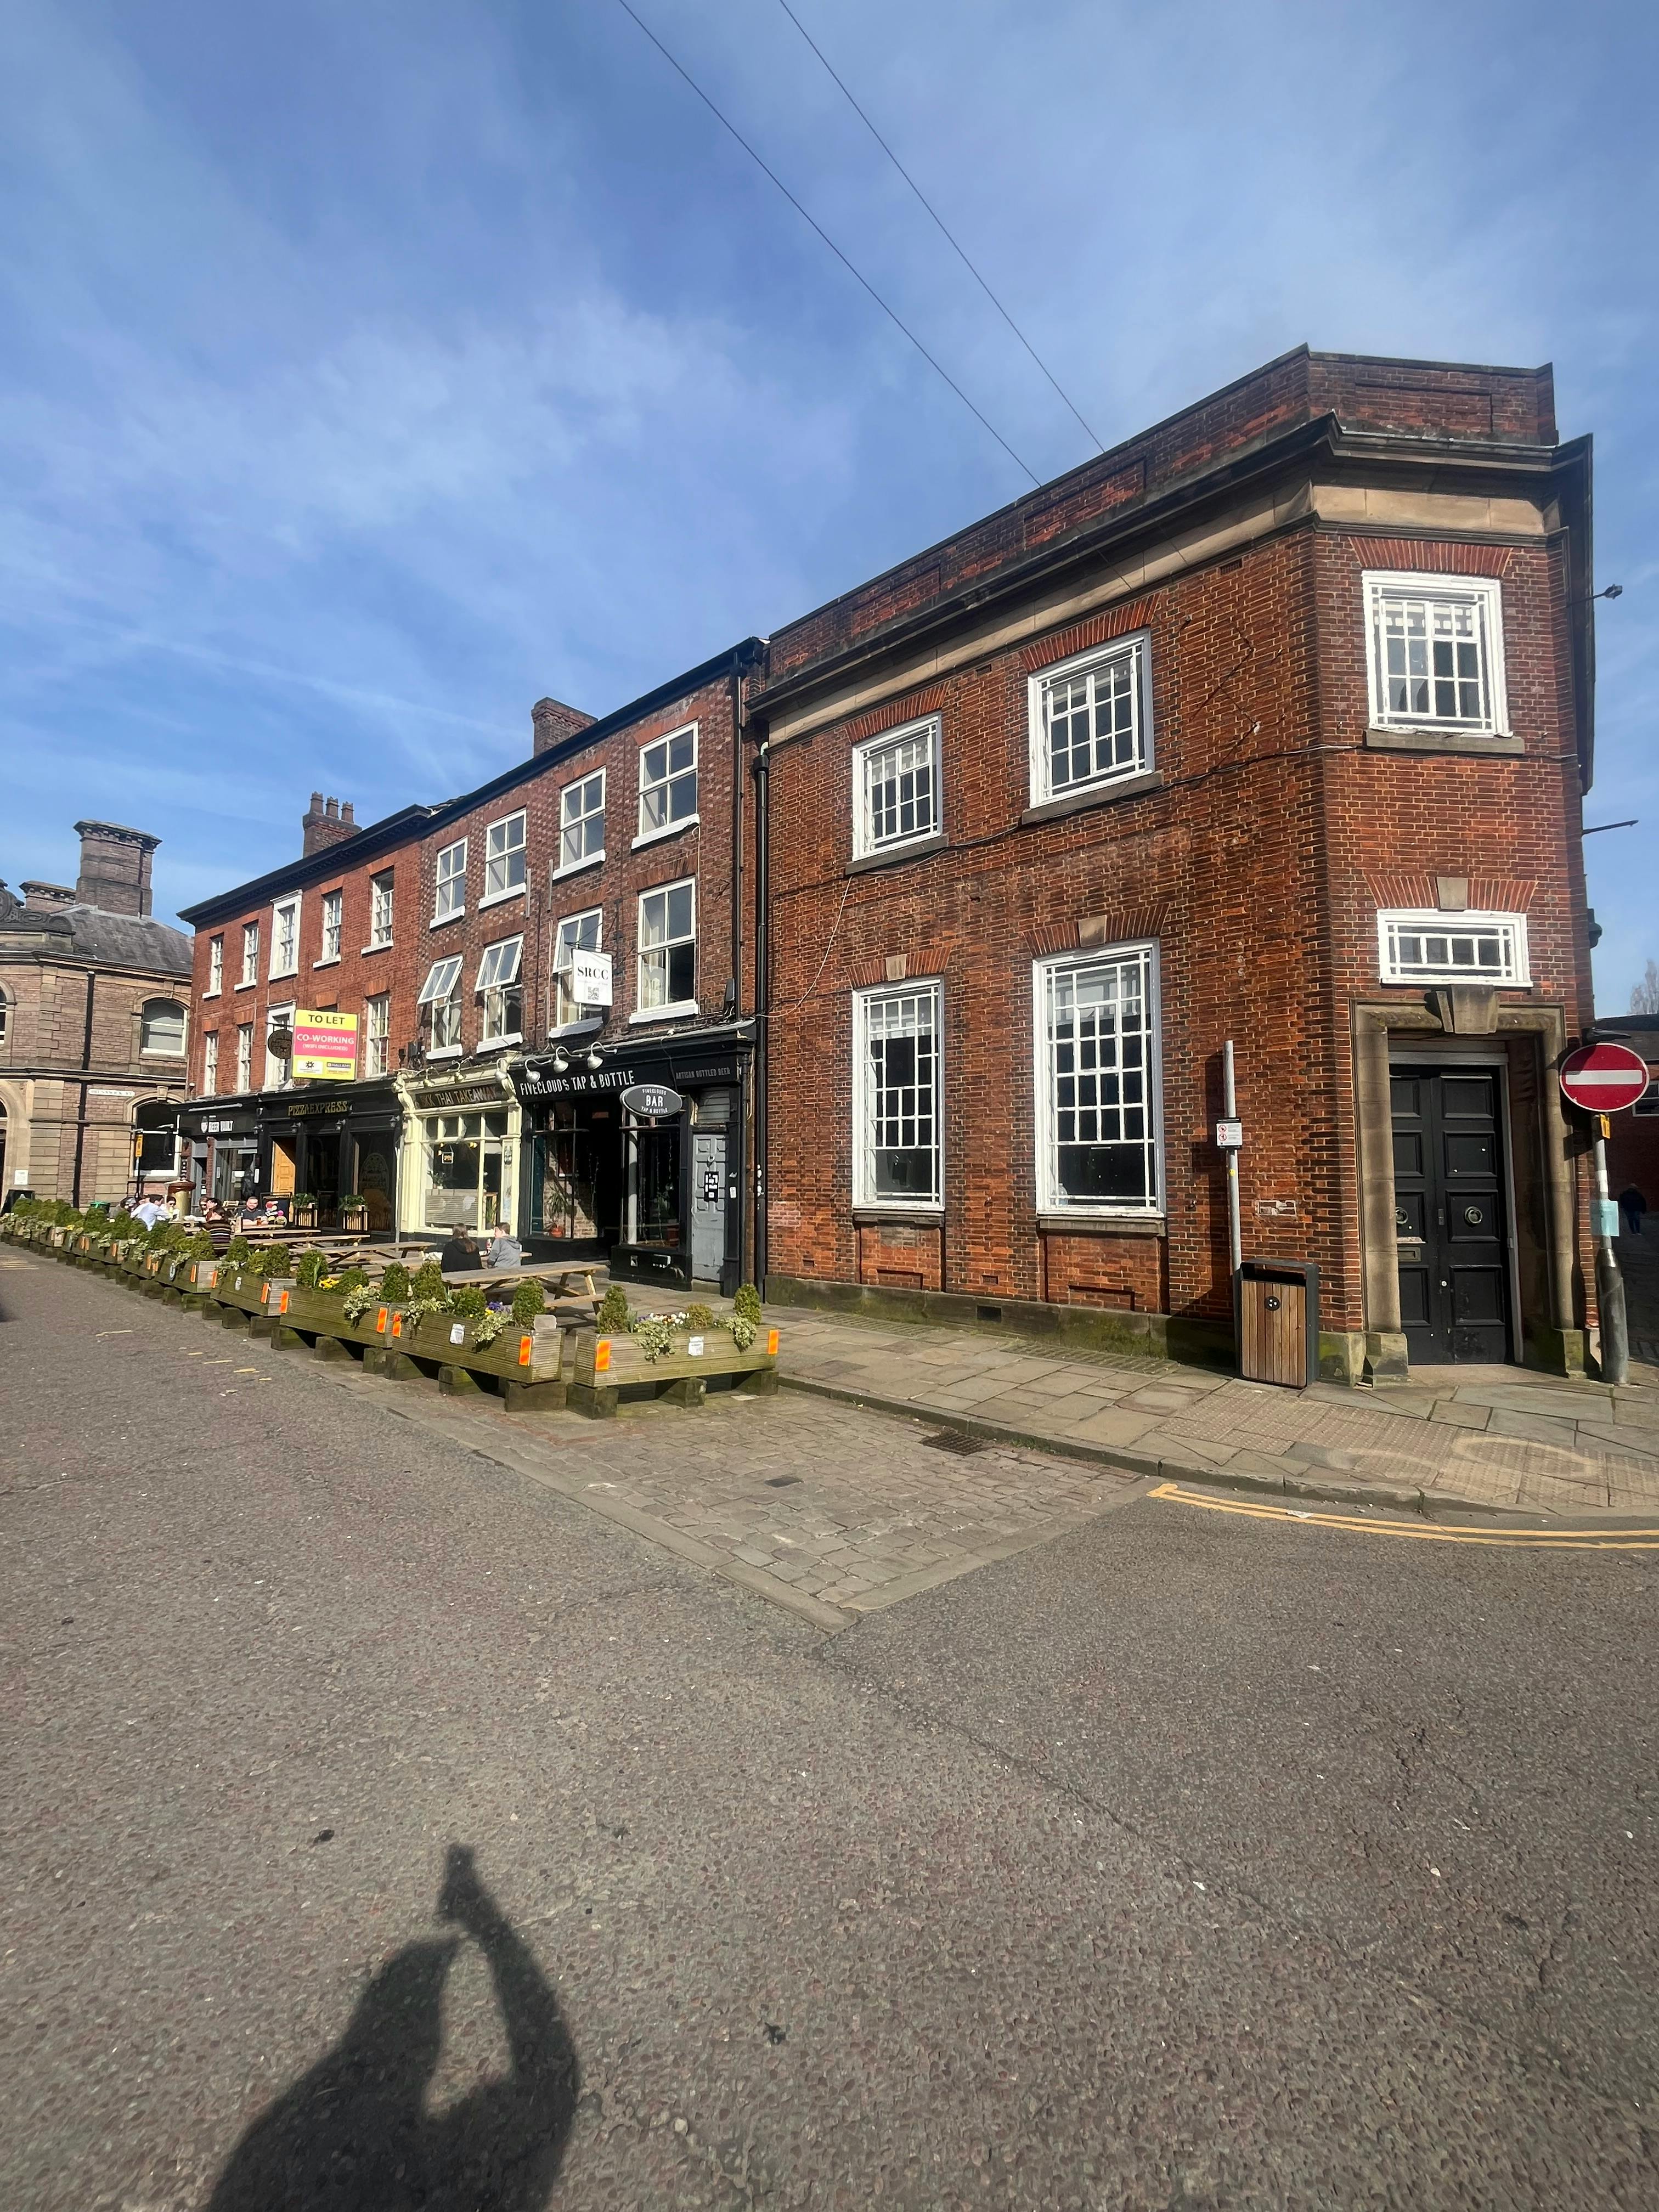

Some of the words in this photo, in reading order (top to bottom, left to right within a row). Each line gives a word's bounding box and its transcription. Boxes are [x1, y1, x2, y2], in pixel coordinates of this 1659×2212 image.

[577, 966, 608, 980] SRCC
[326, 1015, 345, 1025] LET
[296, 1034, 354, 1045] CO-WORKING
[696, 1069, 717, 1077] BOTTLED
[718, 1068, 731, 1076] BEER
[520, 1079, 569, 1096] FIVECLOUDS
[571, 1076, 586, 1091] TAP
[590, 1075, 597, 1089] &
[599, 1070, 635, 1088] BOTTLE
[435, 1091, 454, 1105] THAI
[454, 1087, 496, 1103] TAKEAWAY
[646, 1094, 663, 1107] BAR
[287, 1101, 348, 1116] PIZZAEXPRESS
